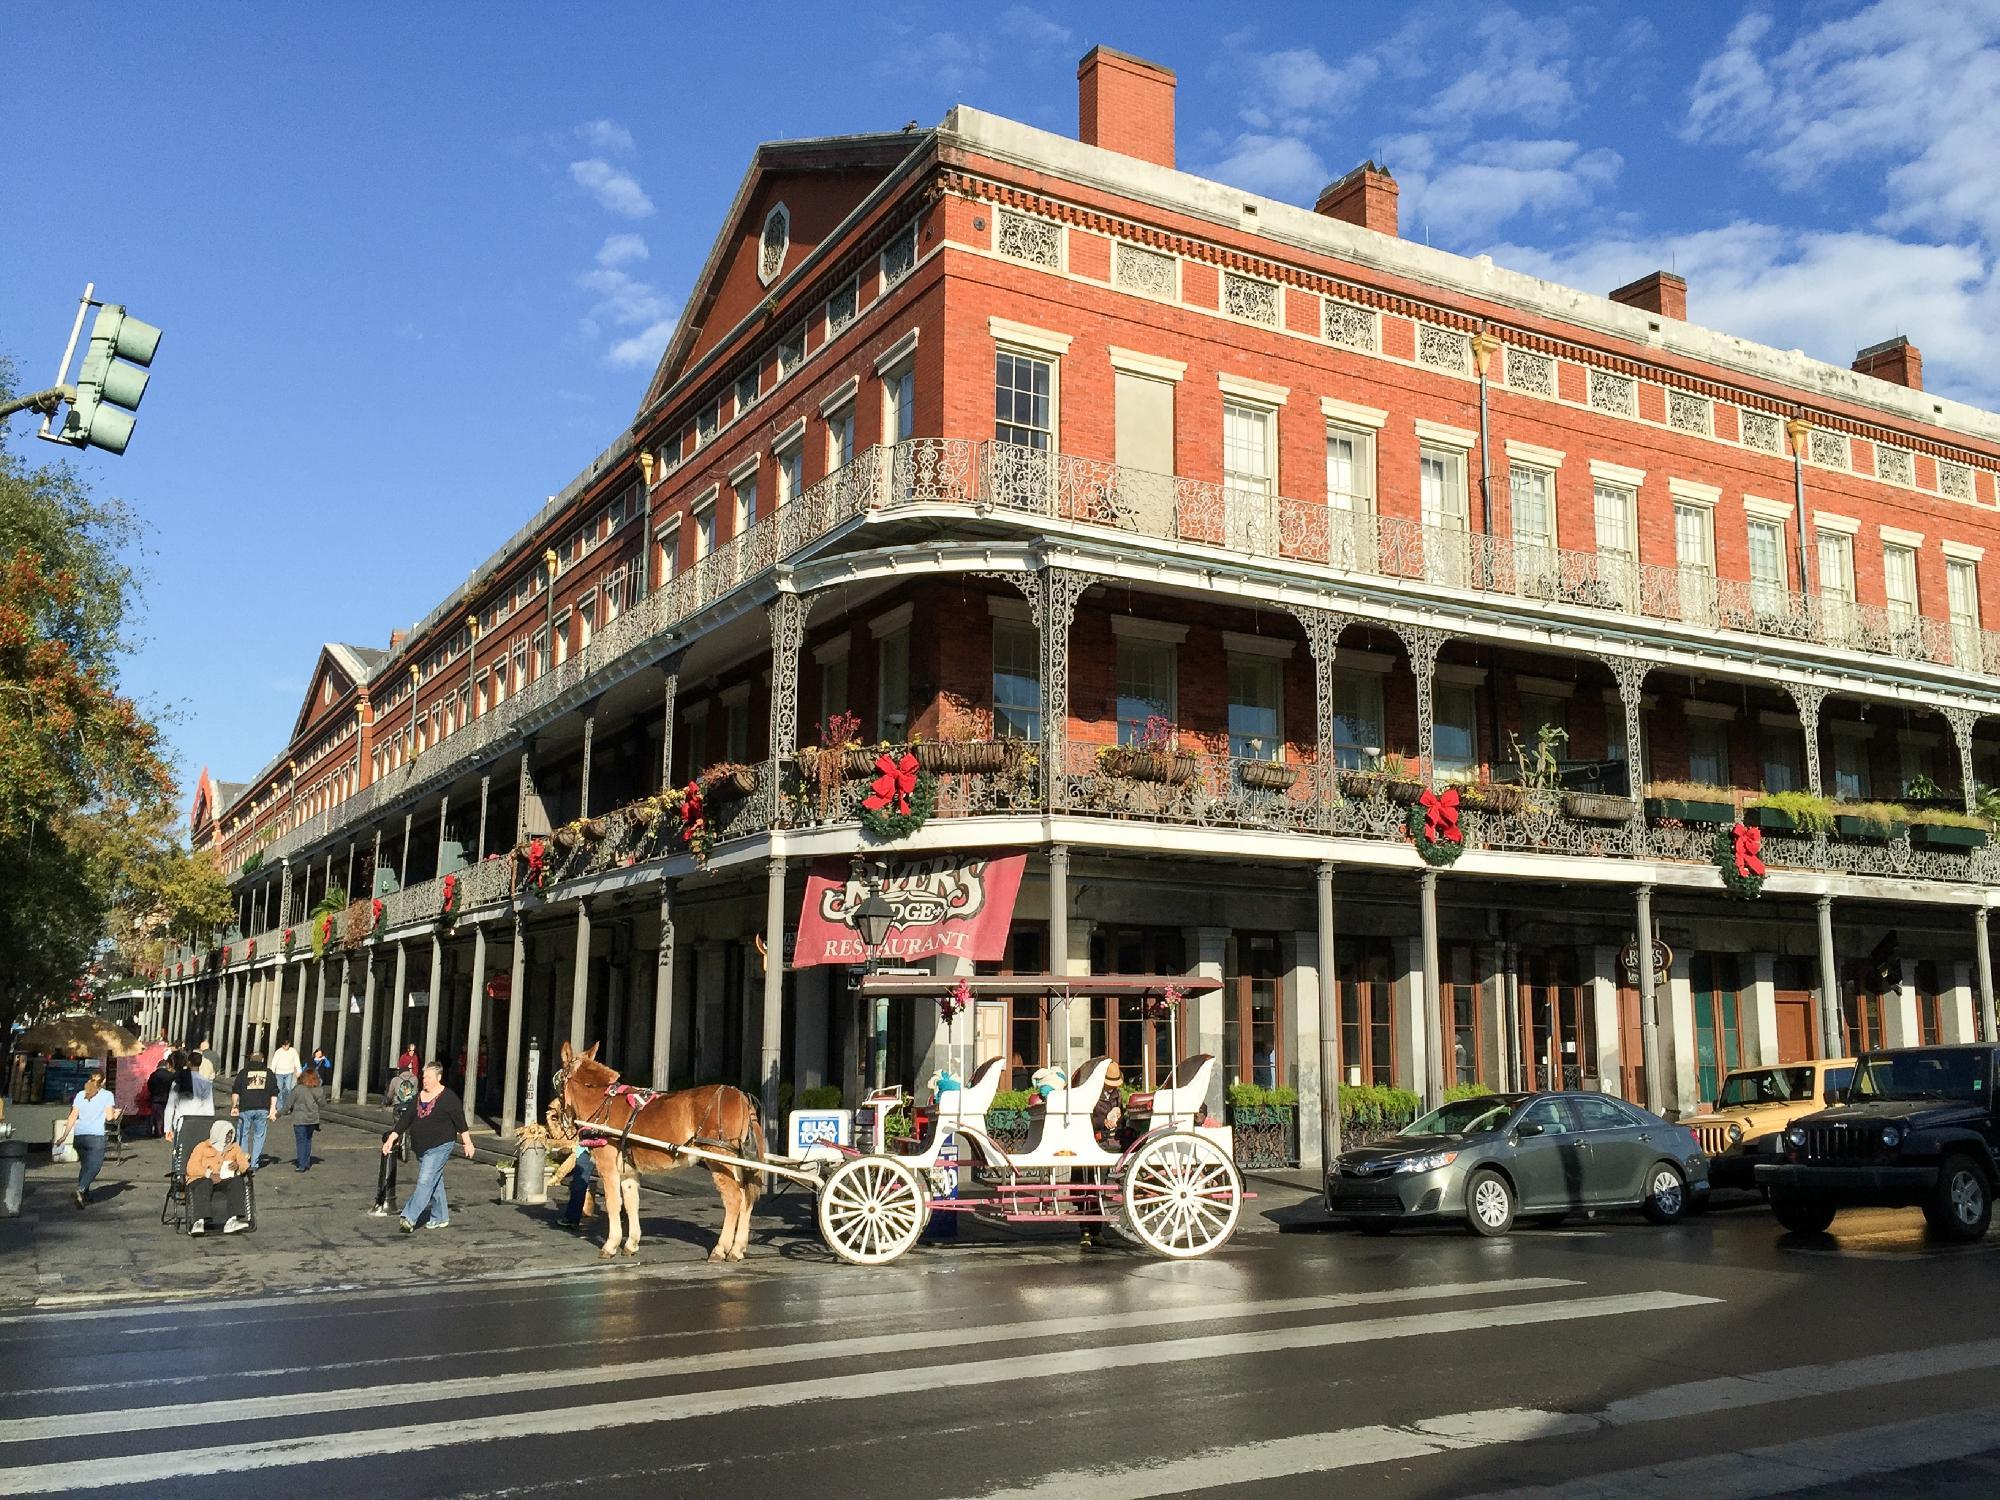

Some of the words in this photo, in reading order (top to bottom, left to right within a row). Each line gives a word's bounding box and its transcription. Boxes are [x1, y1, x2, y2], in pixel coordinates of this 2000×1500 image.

[891, 903, 935, 921] DGE
[812, 1120, 837, 1132] USA
[800, 1131, 838, 1144] TODAY
